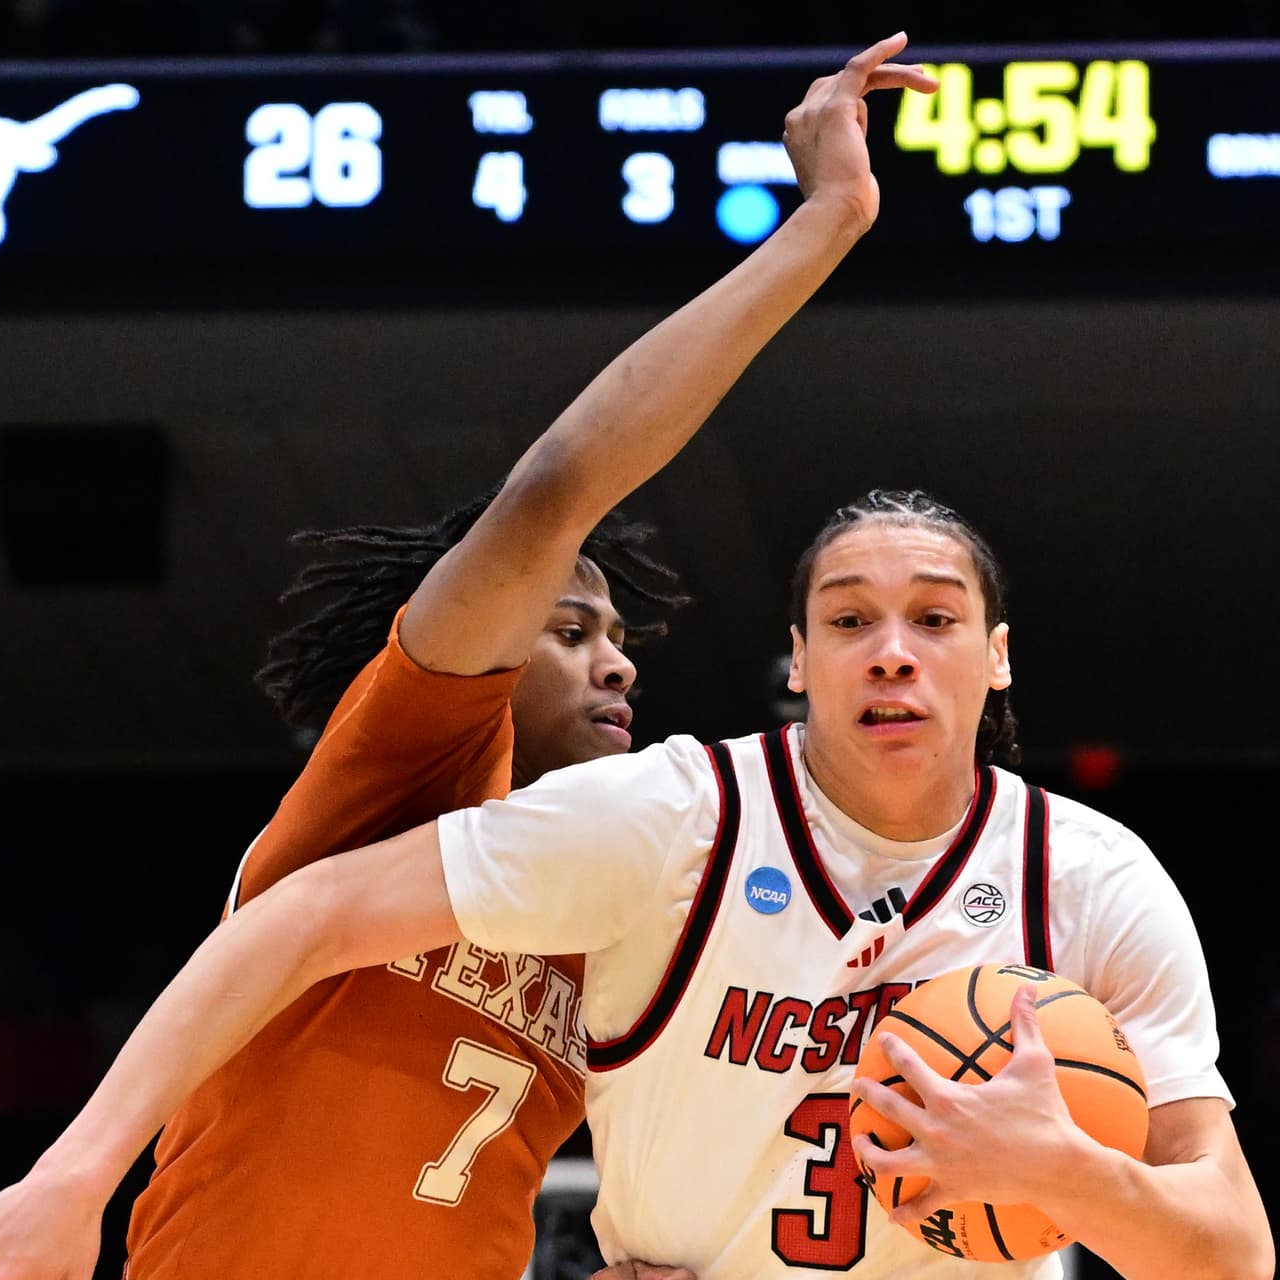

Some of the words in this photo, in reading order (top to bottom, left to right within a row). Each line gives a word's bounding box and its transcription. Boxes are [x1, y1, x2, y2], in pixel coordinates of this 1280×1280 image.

[894, 60, 1157, 174] 4:54
[243, 102, 383, 209] 26
[472, 151, 527, 222] 4
[622, 152, 675, 223] 3
[963, 186, 1071, 242] 1ST
[750, 885, 787, 905] NCAA
[968, 895, 1003, 907] ACC
[412, 1036, 537, 1207] 7
[771, 1092, 870, 1272] 3
